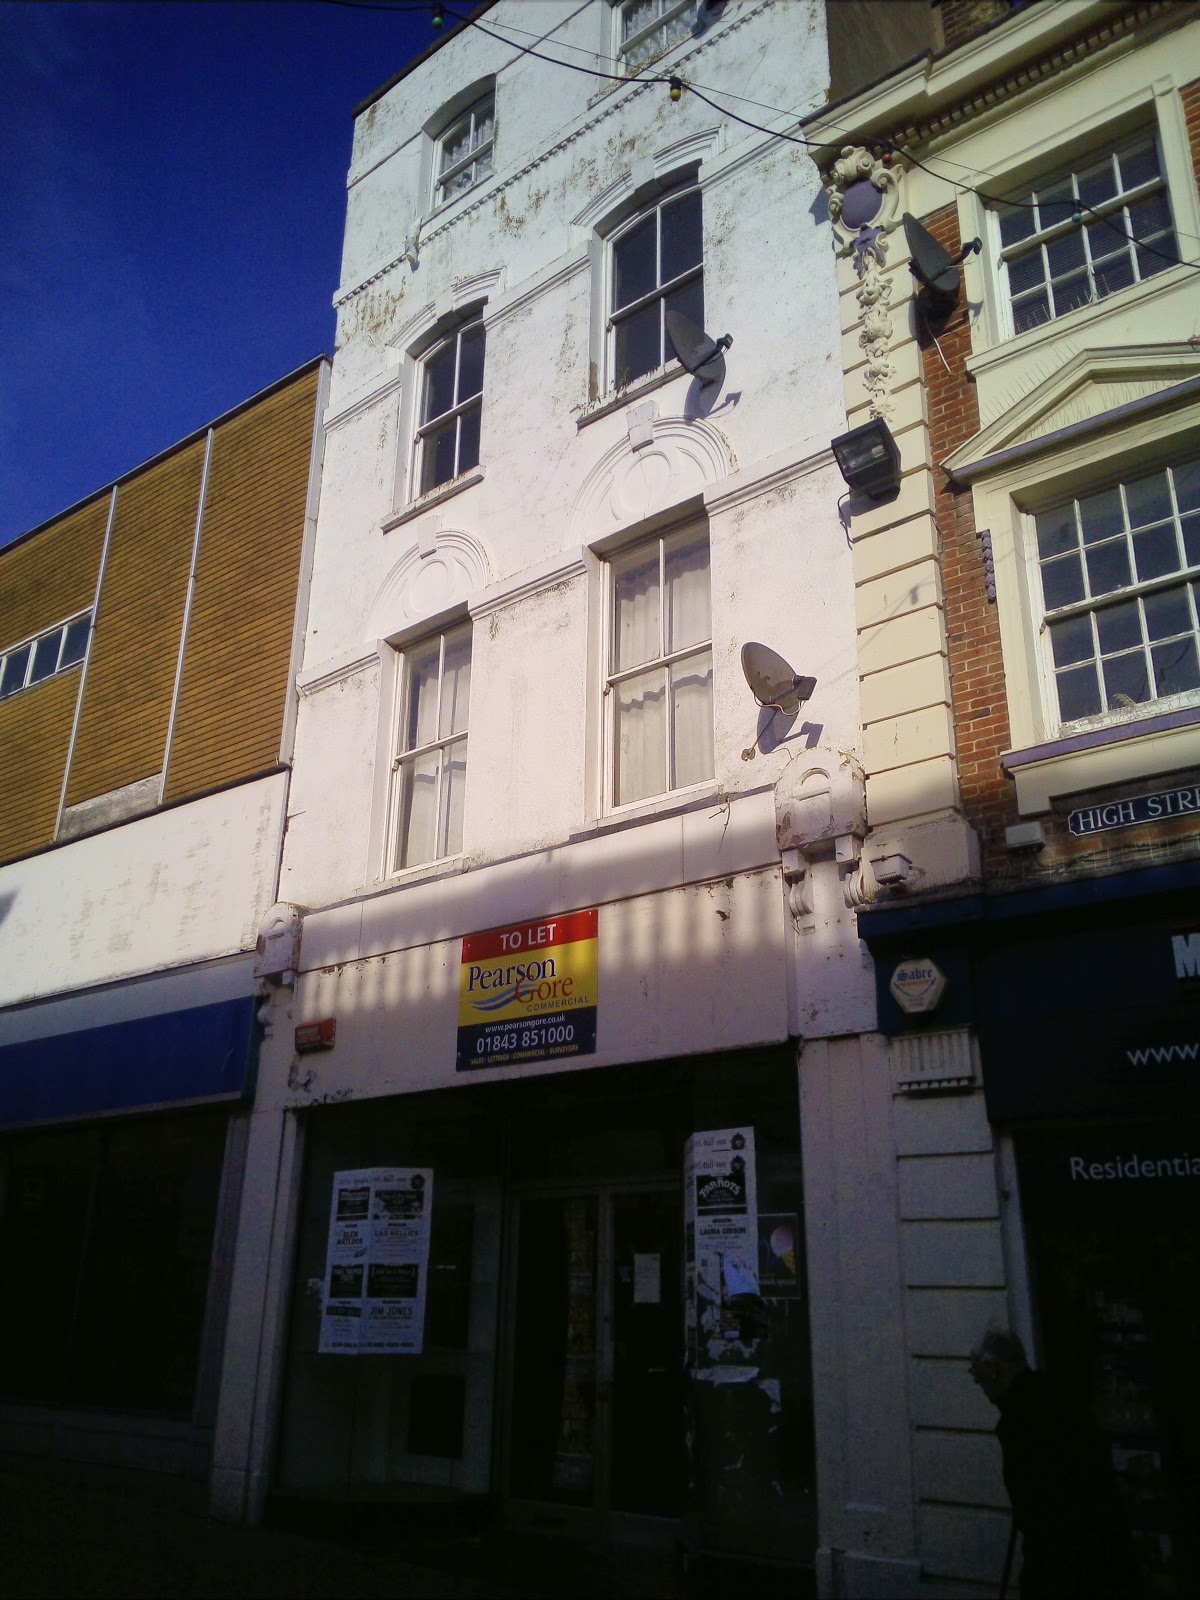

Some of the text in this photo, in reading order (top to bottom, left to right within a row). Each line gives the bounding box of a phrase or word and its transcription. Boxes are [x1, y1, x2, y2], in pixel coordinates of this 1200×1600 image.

[1078, 802, 1135, 831] HIGH
[500, 923, 557, 950] TO LET
[467, 957, 557, 992] Pearson
[896, 968, 933, 982] Sabre
[514, 975, 574, 1004] Gore
[526, 996, 590, 1012] COMMERCIAL
[485, 1014, 566, 1032] www.pearsongore.co.uk
[476, 1025, 575, 1053] 01843 851000
[470, 1043, 579, 1065] SALES LETTINGS COMMERCIAL SURVEYORS
[1069, 1152, 1200, 1182] Residentia
[699, 1178, 742, 1199] PARROTS
[343, 1230, 359, 1239] GLEN
[374, 1229, 389, 1237] LAS
[699, 1226, 746, 1236] LAURA GIBSON
[336, 1237, 364, 1246] MATLOCK
[369, 1306, 384, 1316] JIM
[386, 1306, 413, 1316] JONES
